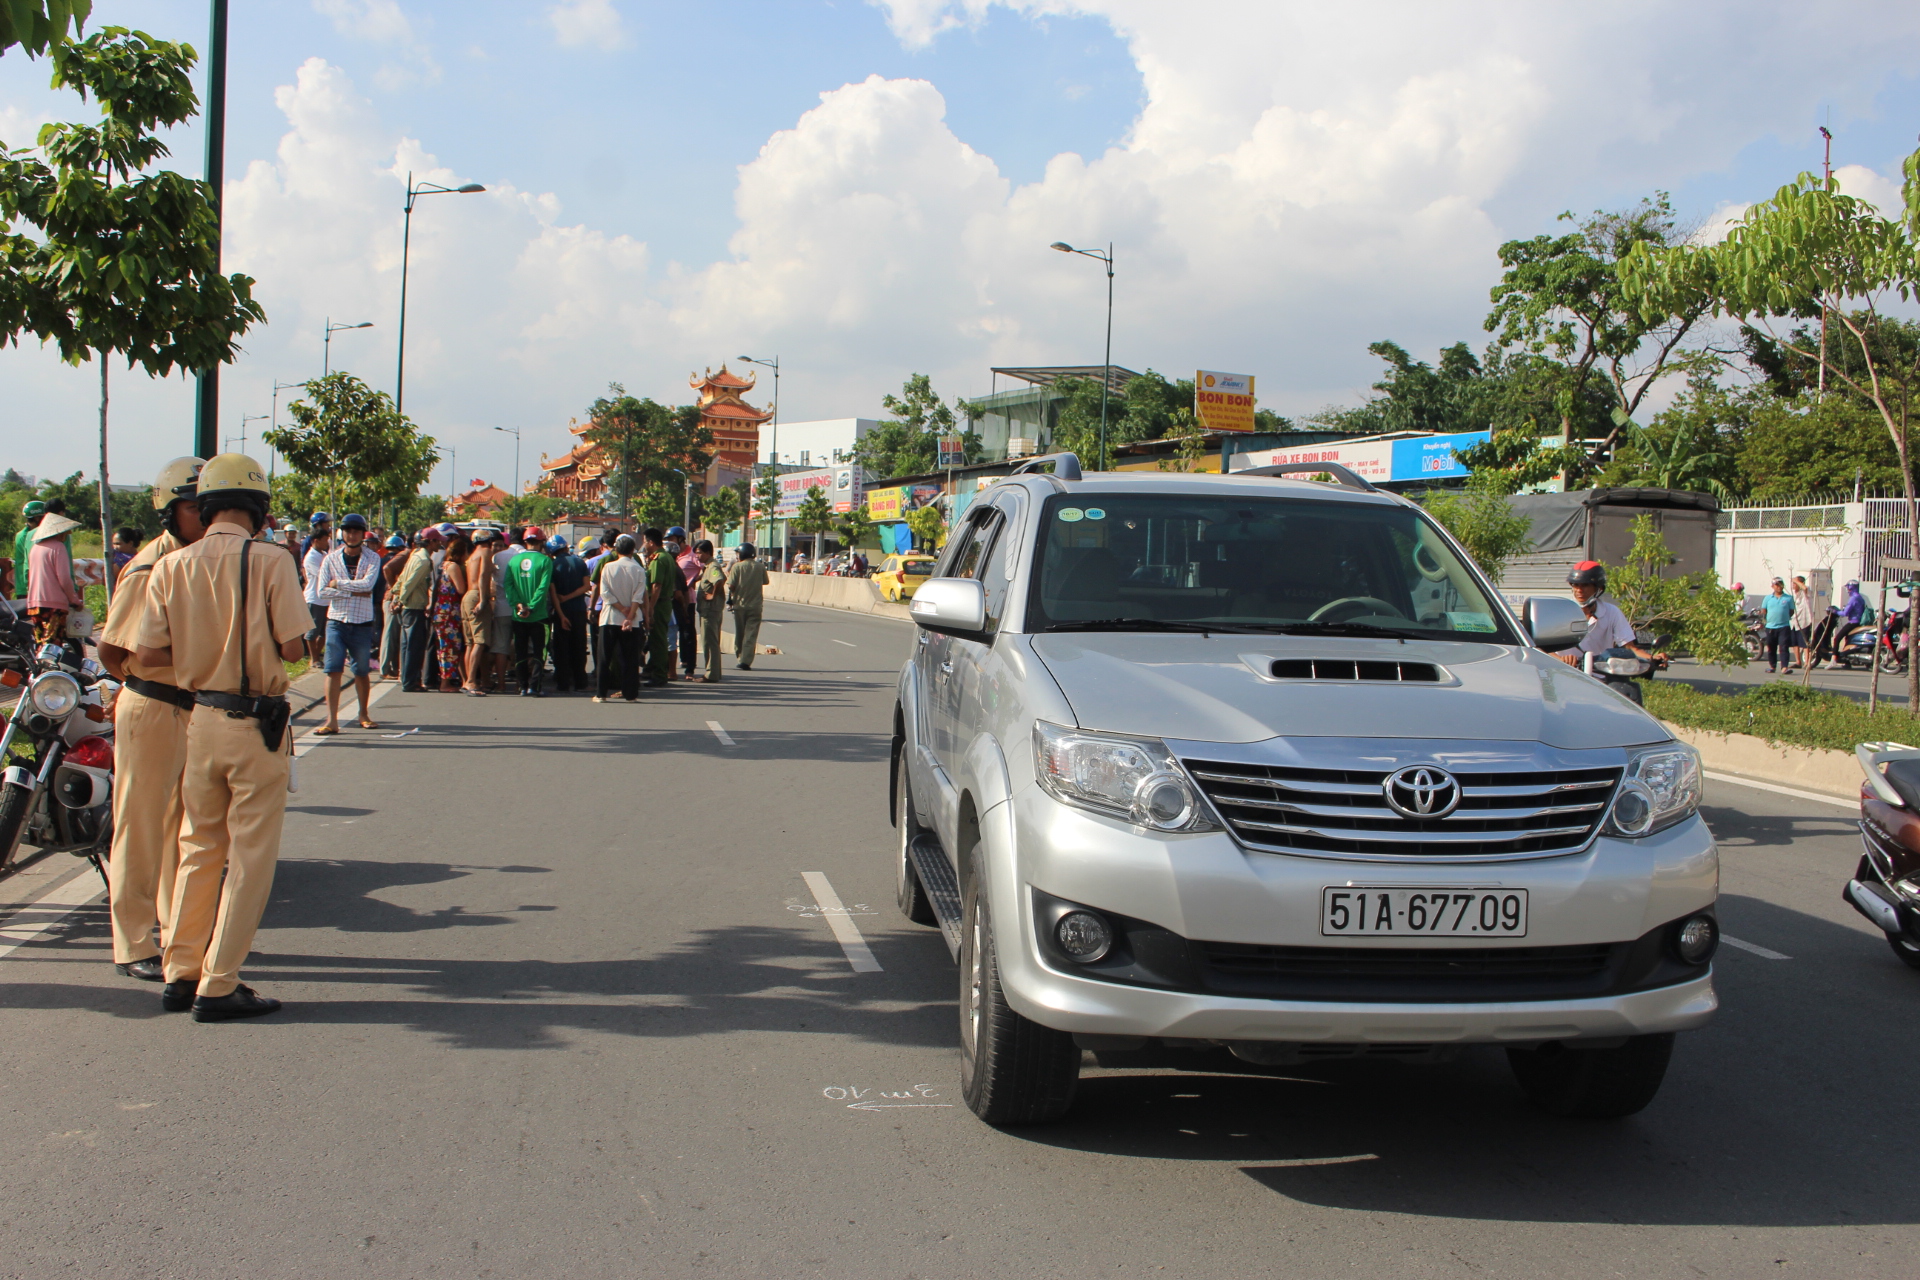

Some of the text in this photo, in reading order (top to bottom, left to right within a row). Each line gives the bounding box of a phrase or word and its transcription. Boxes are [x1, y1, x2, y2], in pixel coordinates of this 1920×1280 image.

[1198, 392, 1252, 407] BON BON
[1290, 454, 1301, 464] XE
[1302, 453, 1319, 463] BON
[1321, 451, 1339, 462] BON
[1422, 454, 1455, 472] Mobil
[783, 479, 800, 491] PHI
[1330, 893, 1521, 931] 51A-677.09
